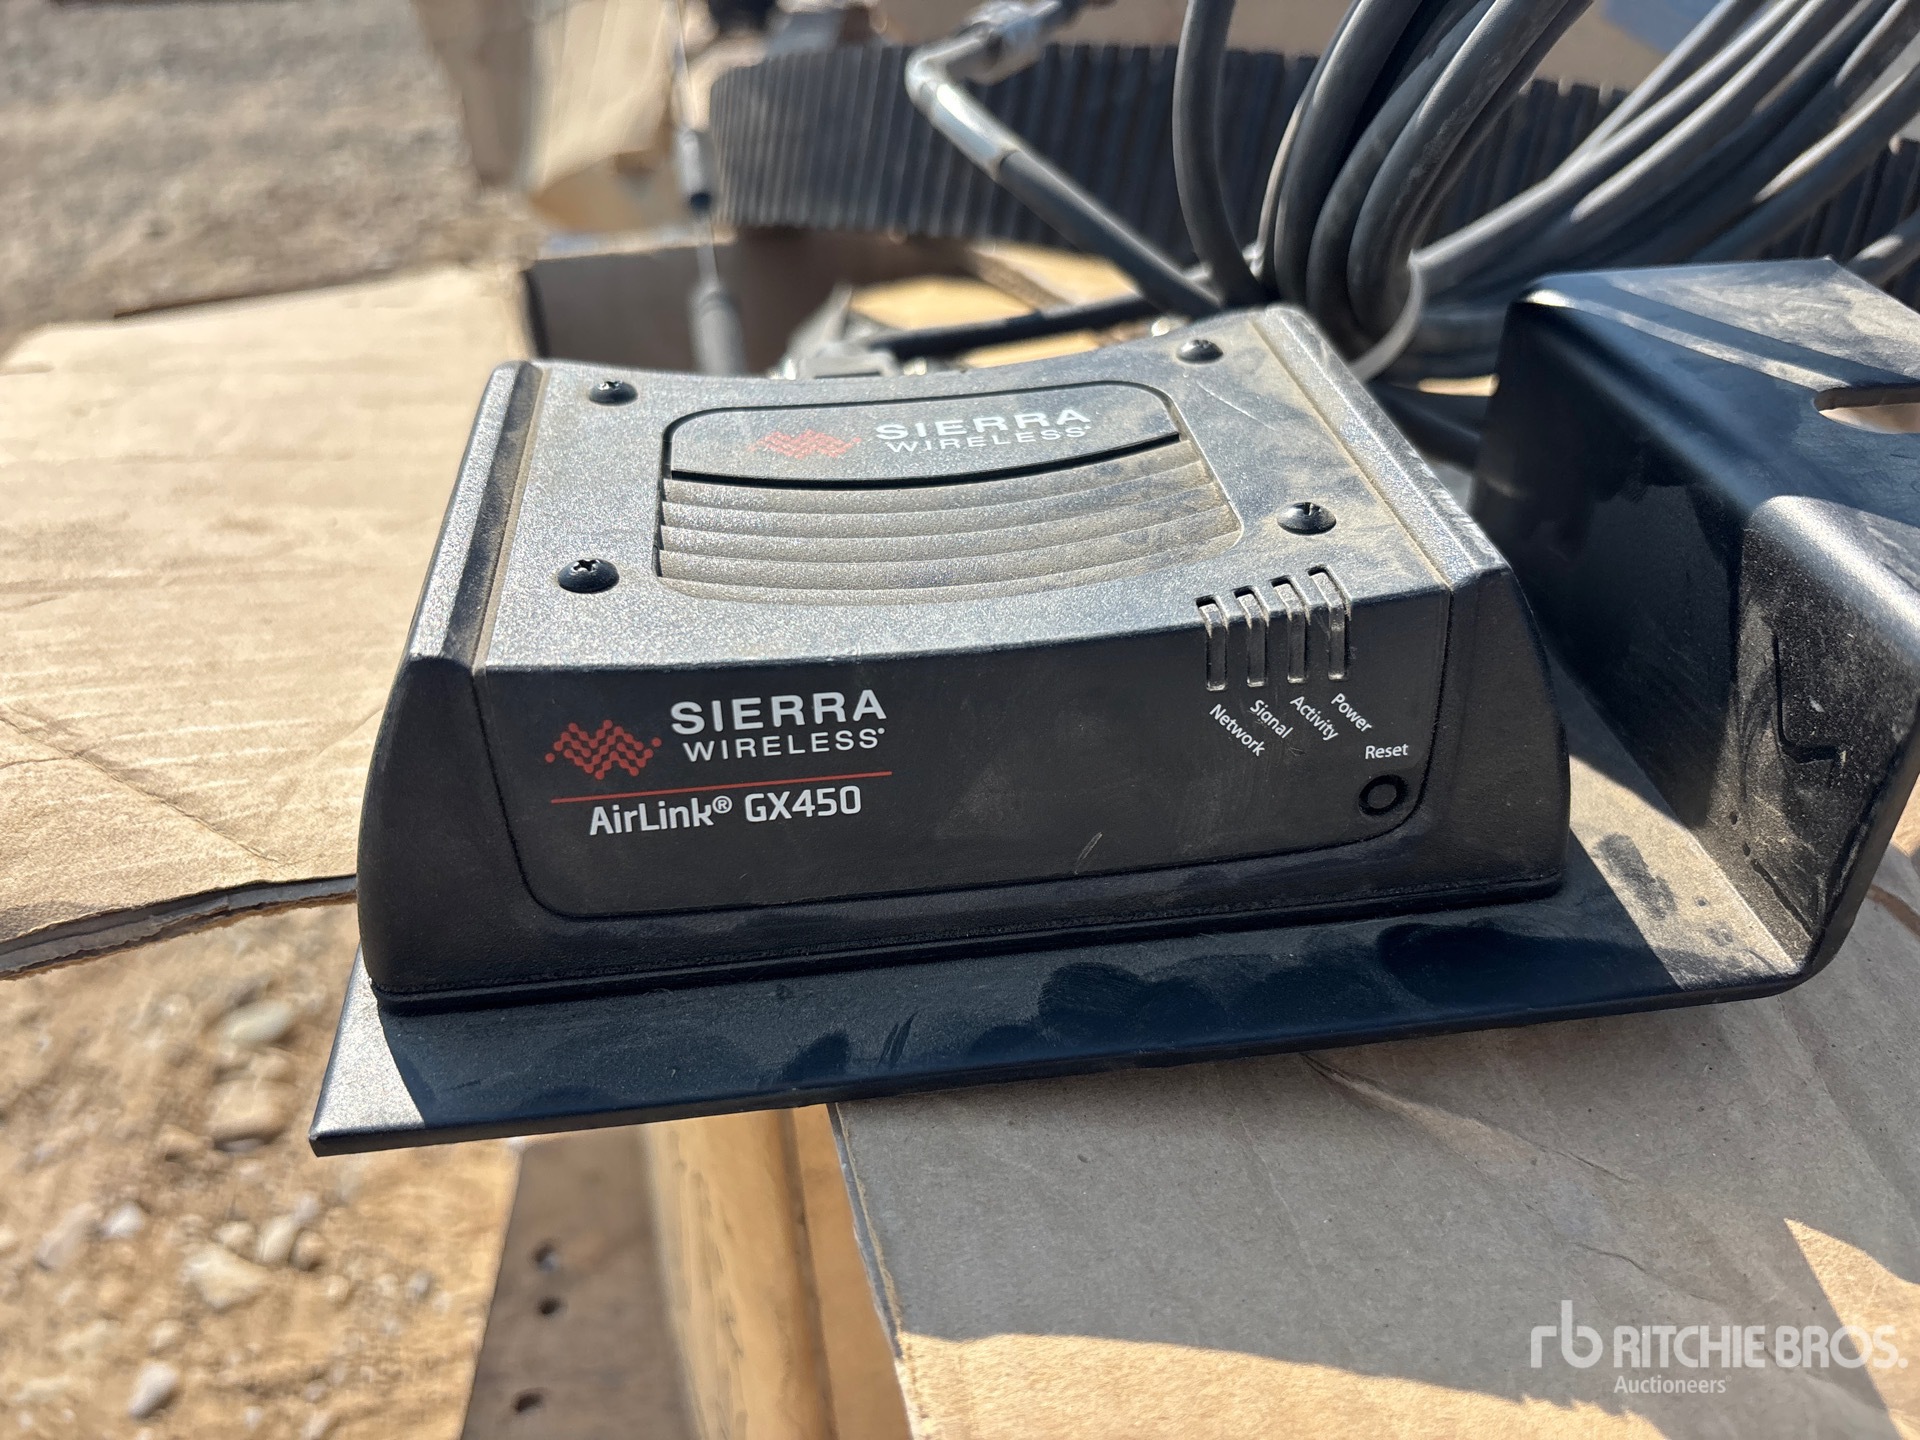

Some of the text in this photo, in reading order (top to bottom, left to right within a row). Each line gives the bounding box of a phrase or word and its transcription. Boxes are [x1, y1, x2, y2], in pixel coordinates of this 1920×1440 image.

[876, 409, 1091, 440] SIERRA
[670, 689, 887, 735] SIERRA
[1209, 703, 1265, 757] Network
[1250, 699, 1293, 739] Signal
[1289, 695, 1339, 741] Activity
[1330, 693, 1373, 733] Power
[1365, 743, 1409, 759] Reset
[745, 785, 861, 822] GX450
